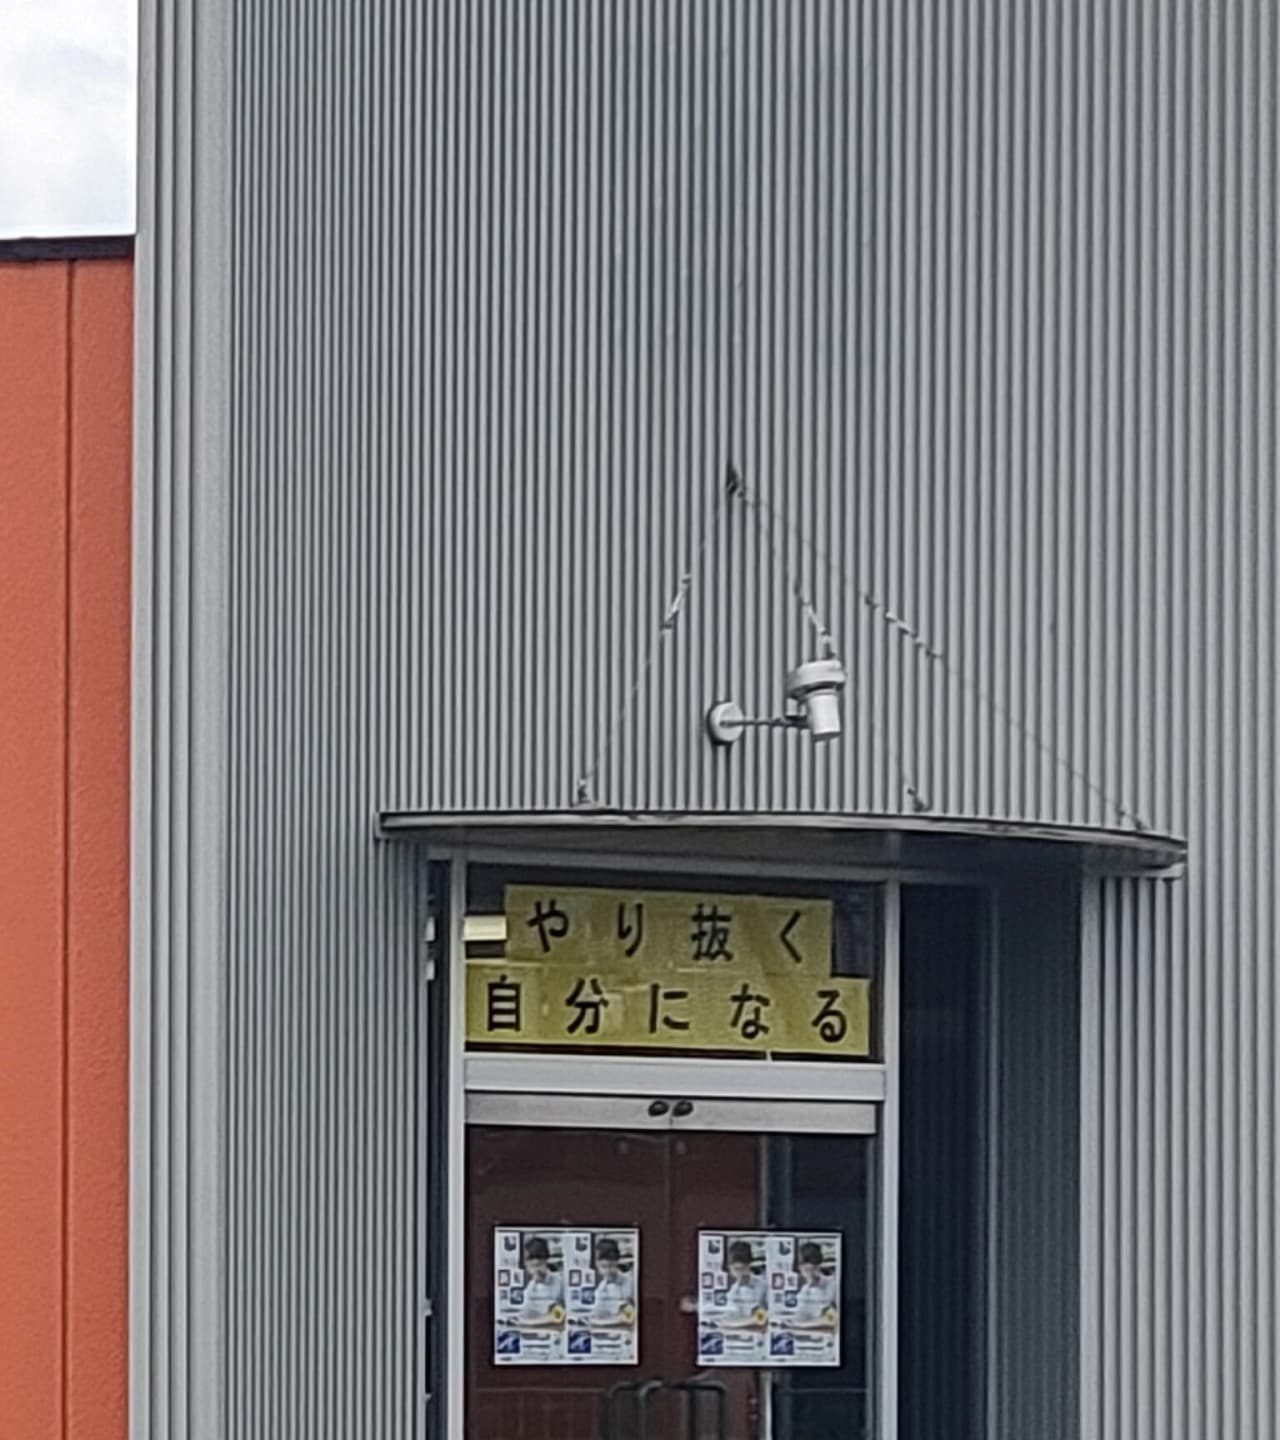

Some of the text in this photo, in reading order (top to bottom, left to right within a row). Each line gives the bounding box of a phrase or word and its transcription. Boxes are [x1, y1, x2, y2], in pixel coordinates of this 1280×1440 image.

[526, 899, 803, 963] やり抜く
[487, 974, 848, 1043] 自分になる
